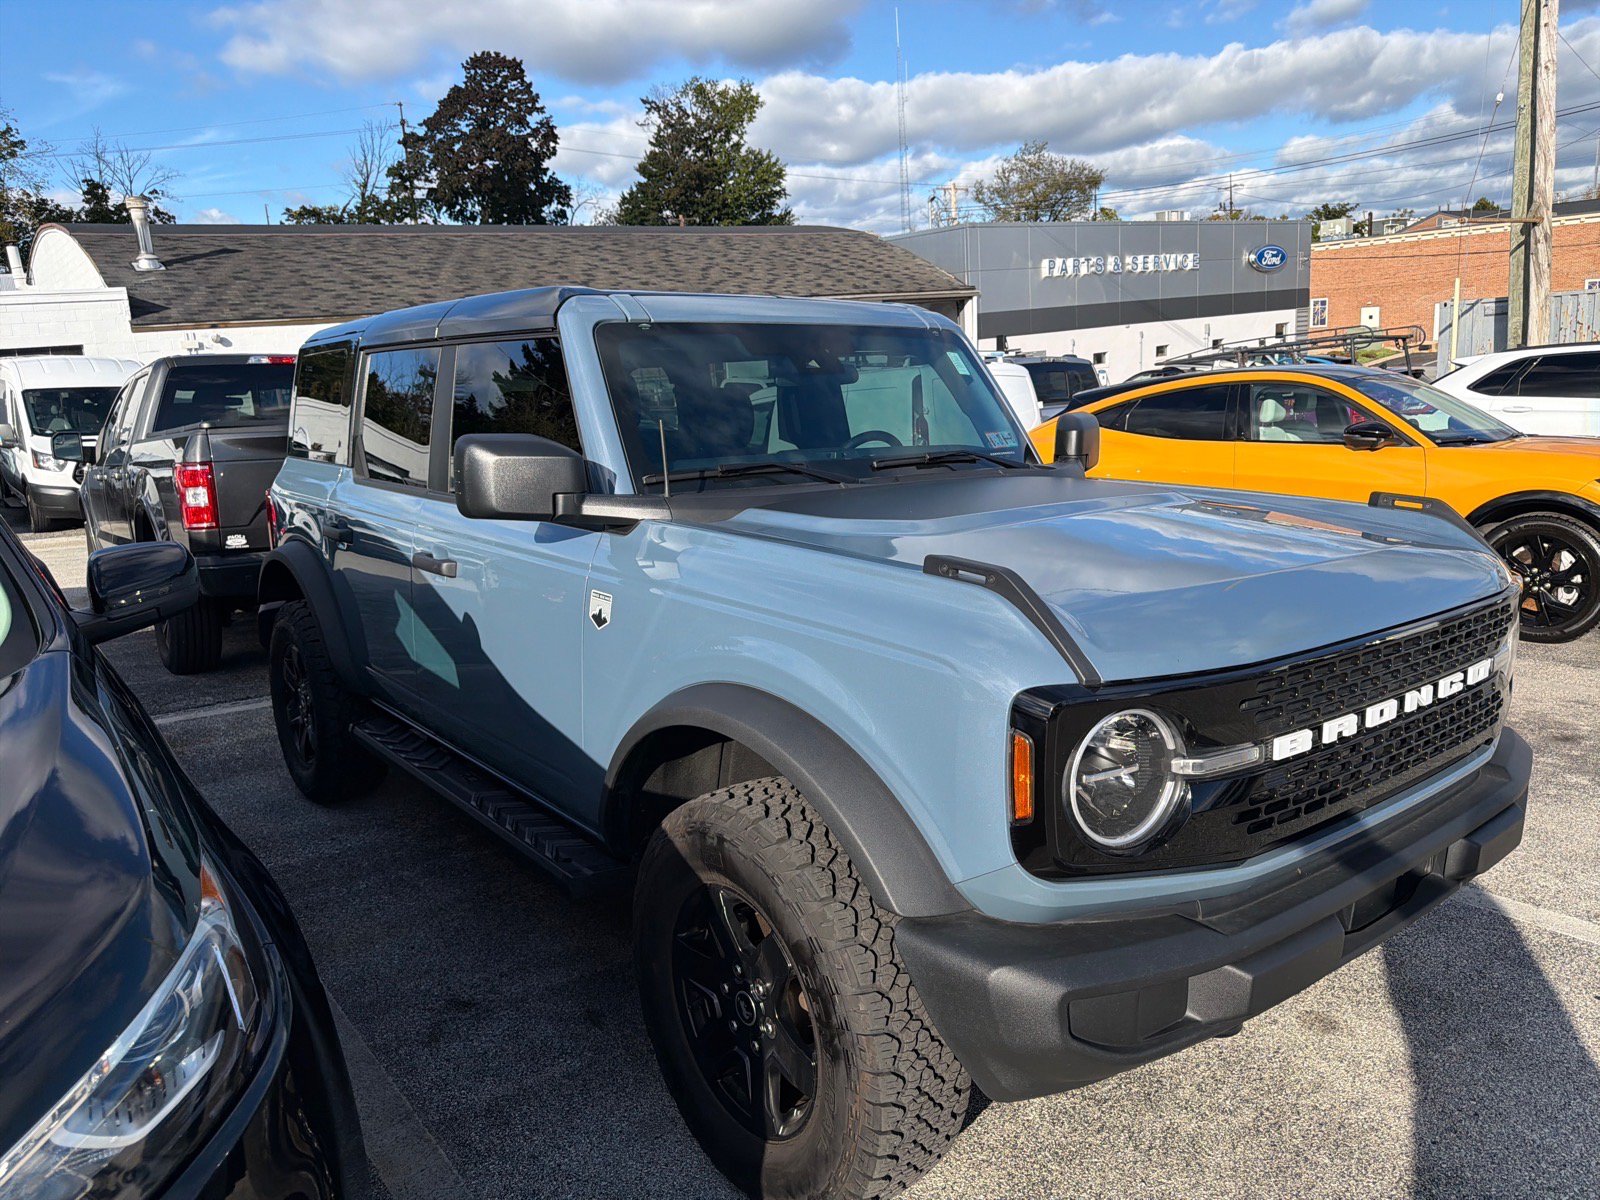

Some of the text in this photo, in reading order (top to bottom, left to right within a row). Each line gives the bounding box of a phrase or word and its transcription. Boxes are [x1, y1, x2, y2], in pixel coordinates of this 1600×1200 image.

[1044, 253, 1200, 277] PARTS & SERVICE
[1262, 250, 1282, 266] Ford
[1272, 658, 1492, 761] BRONCO
